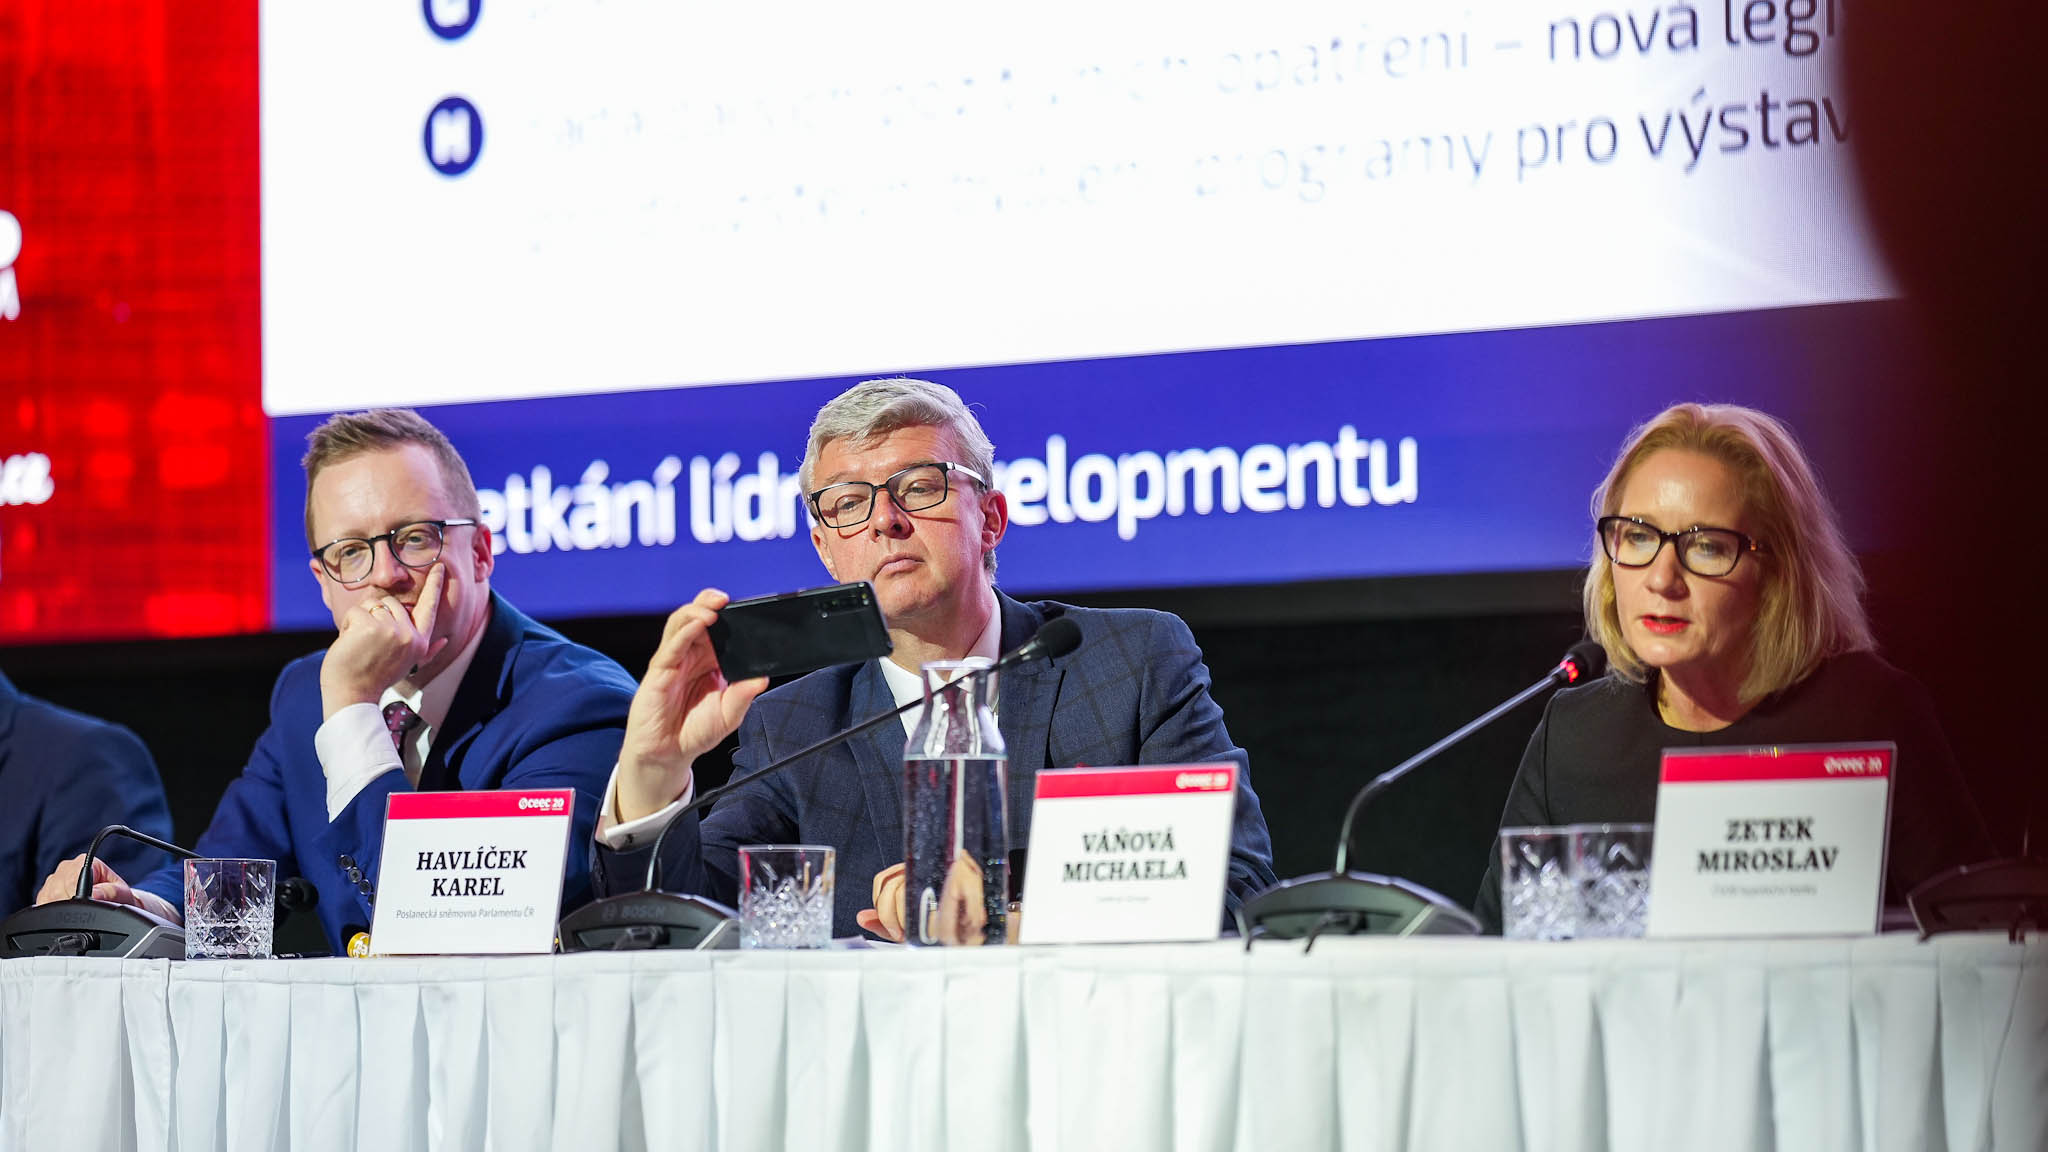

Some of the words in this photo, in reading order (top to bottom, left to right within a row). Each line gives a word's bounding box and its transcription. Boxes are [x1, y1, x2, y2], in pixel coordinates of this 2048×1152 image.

[1516, 112, 1621, 183] pro
[690, 451, 802, 544] lídr
[1082, 827, 1176, 853] VÁŇOVÁ
[1725, 816, 1815, 842] ZETEK
[416, 846, 528, 871] HAVLÍČEK
[1062, 860, 1187, 882] MICHAELA
[1697, 847, 1838, 873] MIROSLAV
[431, 877, 505, 897] KAREL
[396, 907, 437, 919] Poslanecká
[439, 907, 477, 919] sněmovna
[479, 907, 522, 918] Parlamentu
[622, 904, 666, 919] BOSCH
